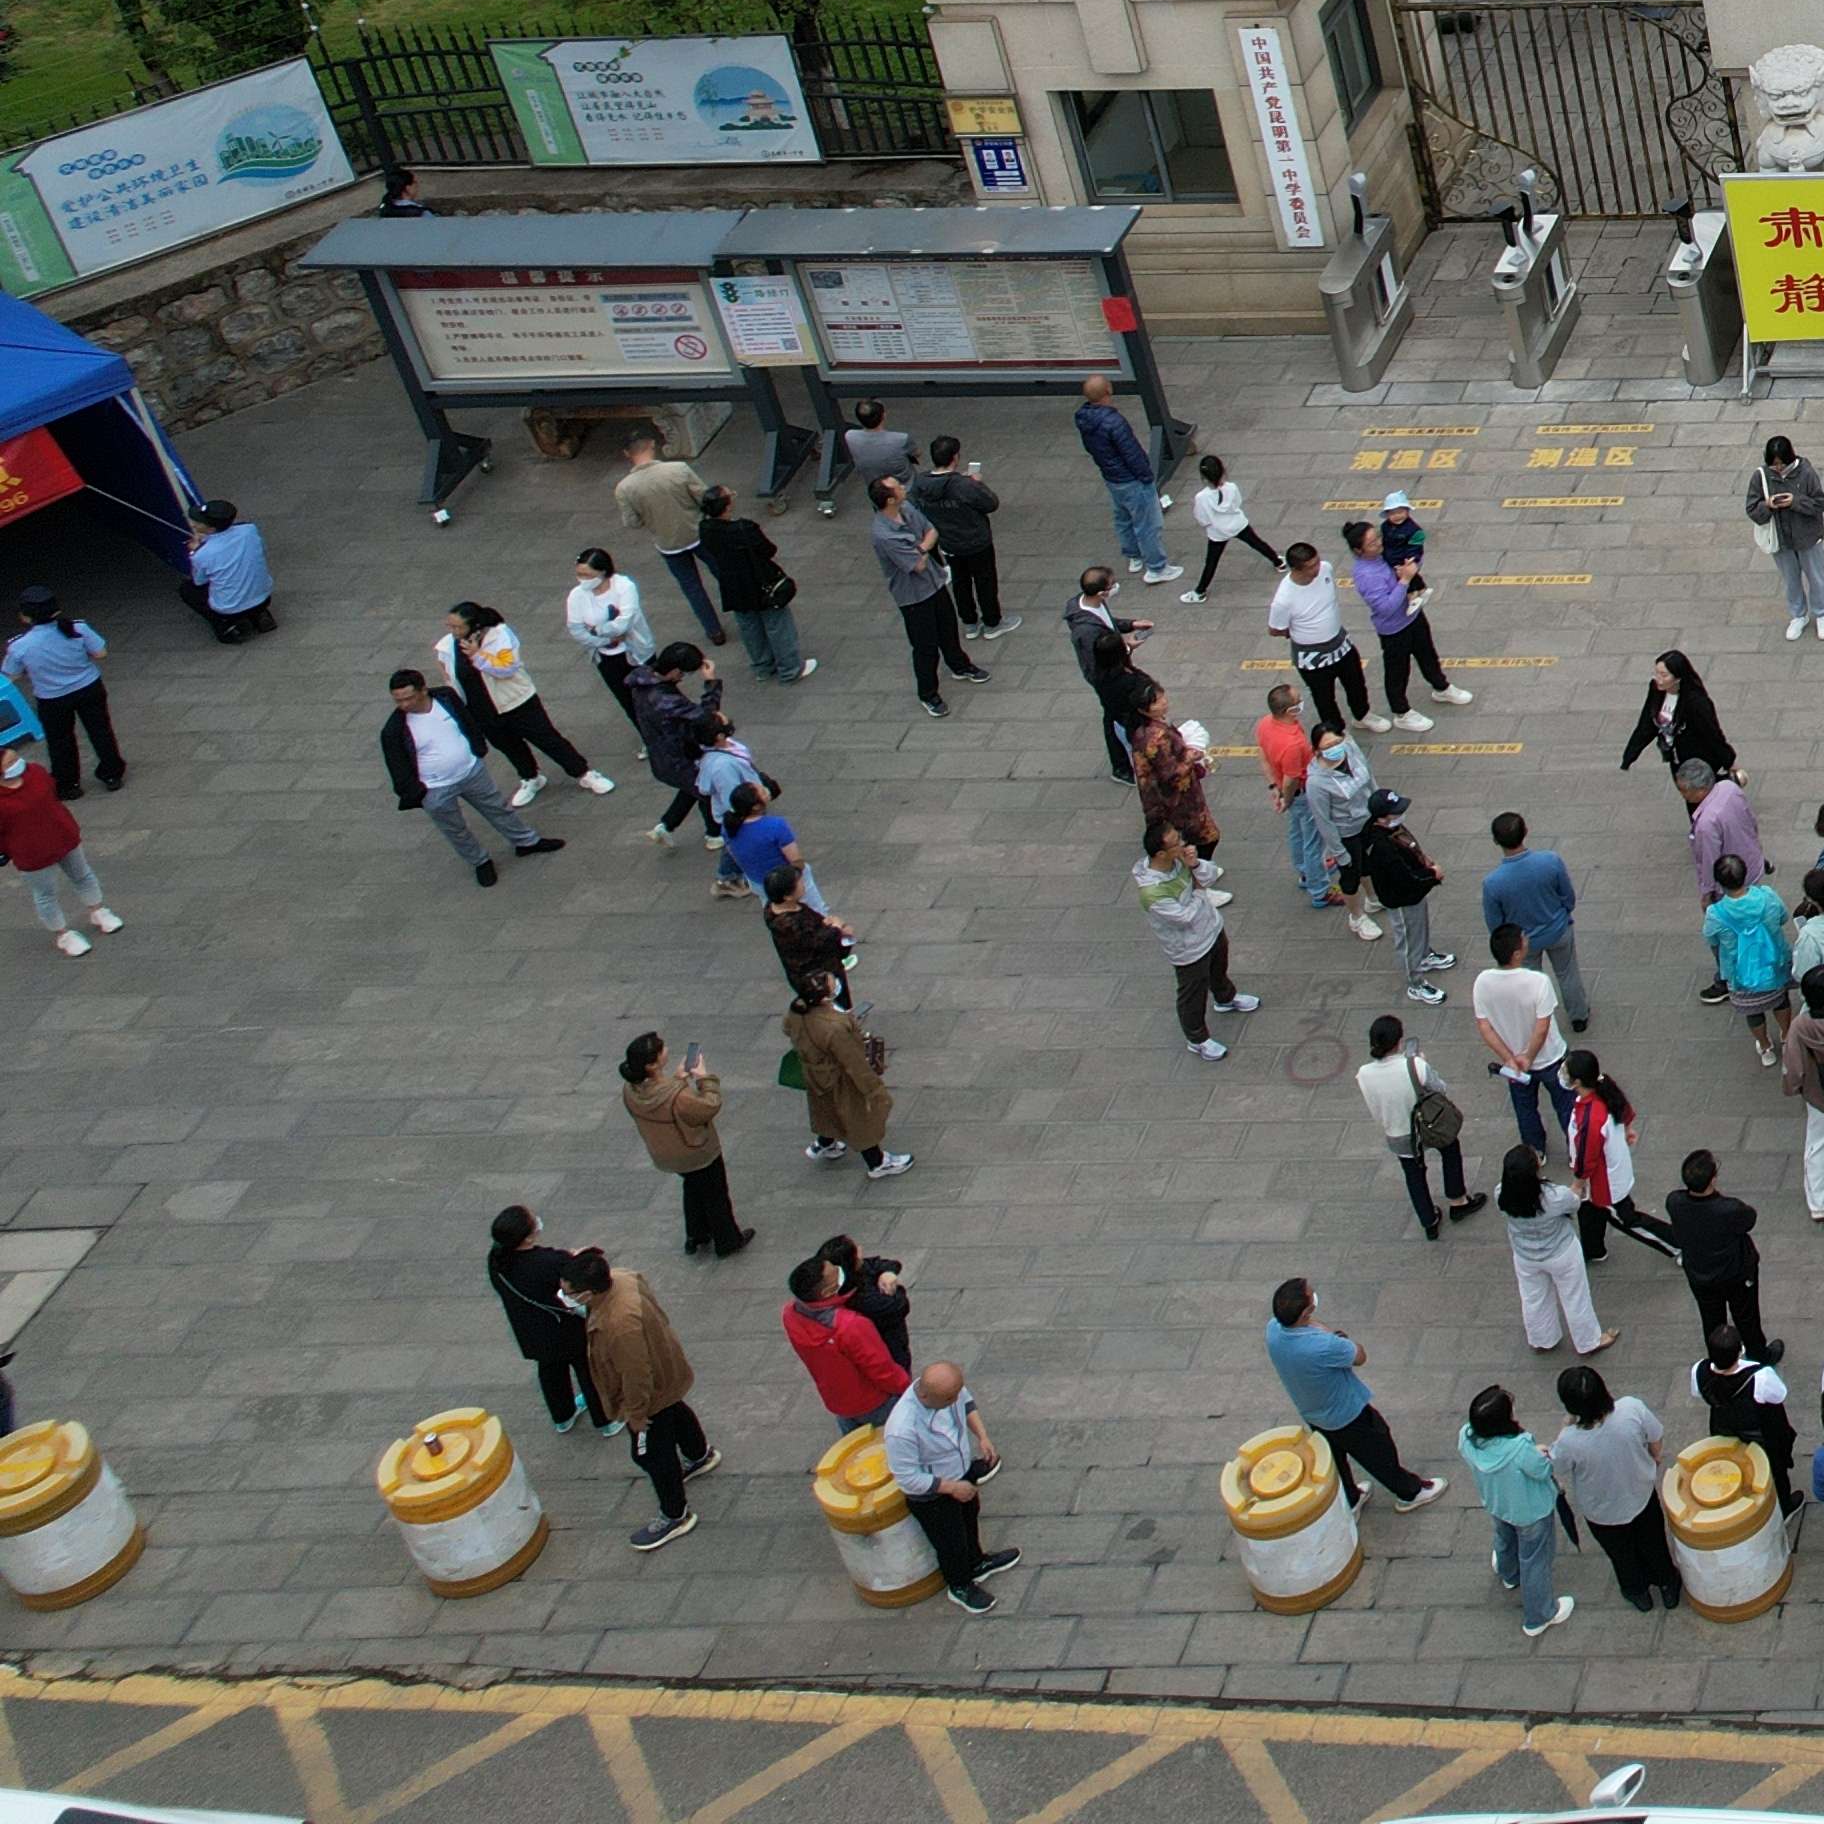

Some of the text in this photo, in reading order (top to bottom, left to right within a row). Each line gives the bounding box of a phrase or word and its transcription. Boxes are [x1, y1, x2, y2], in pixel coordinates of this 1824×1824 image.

[1251, 36, 1311, 239] 中国共产党昆明第一中学委员会
[61, 159, 201, 213] 爱护公共环境卫生
[1353, 448, 1457, 470] 测温区
[1529, 447, 1633, 468] 测温区
